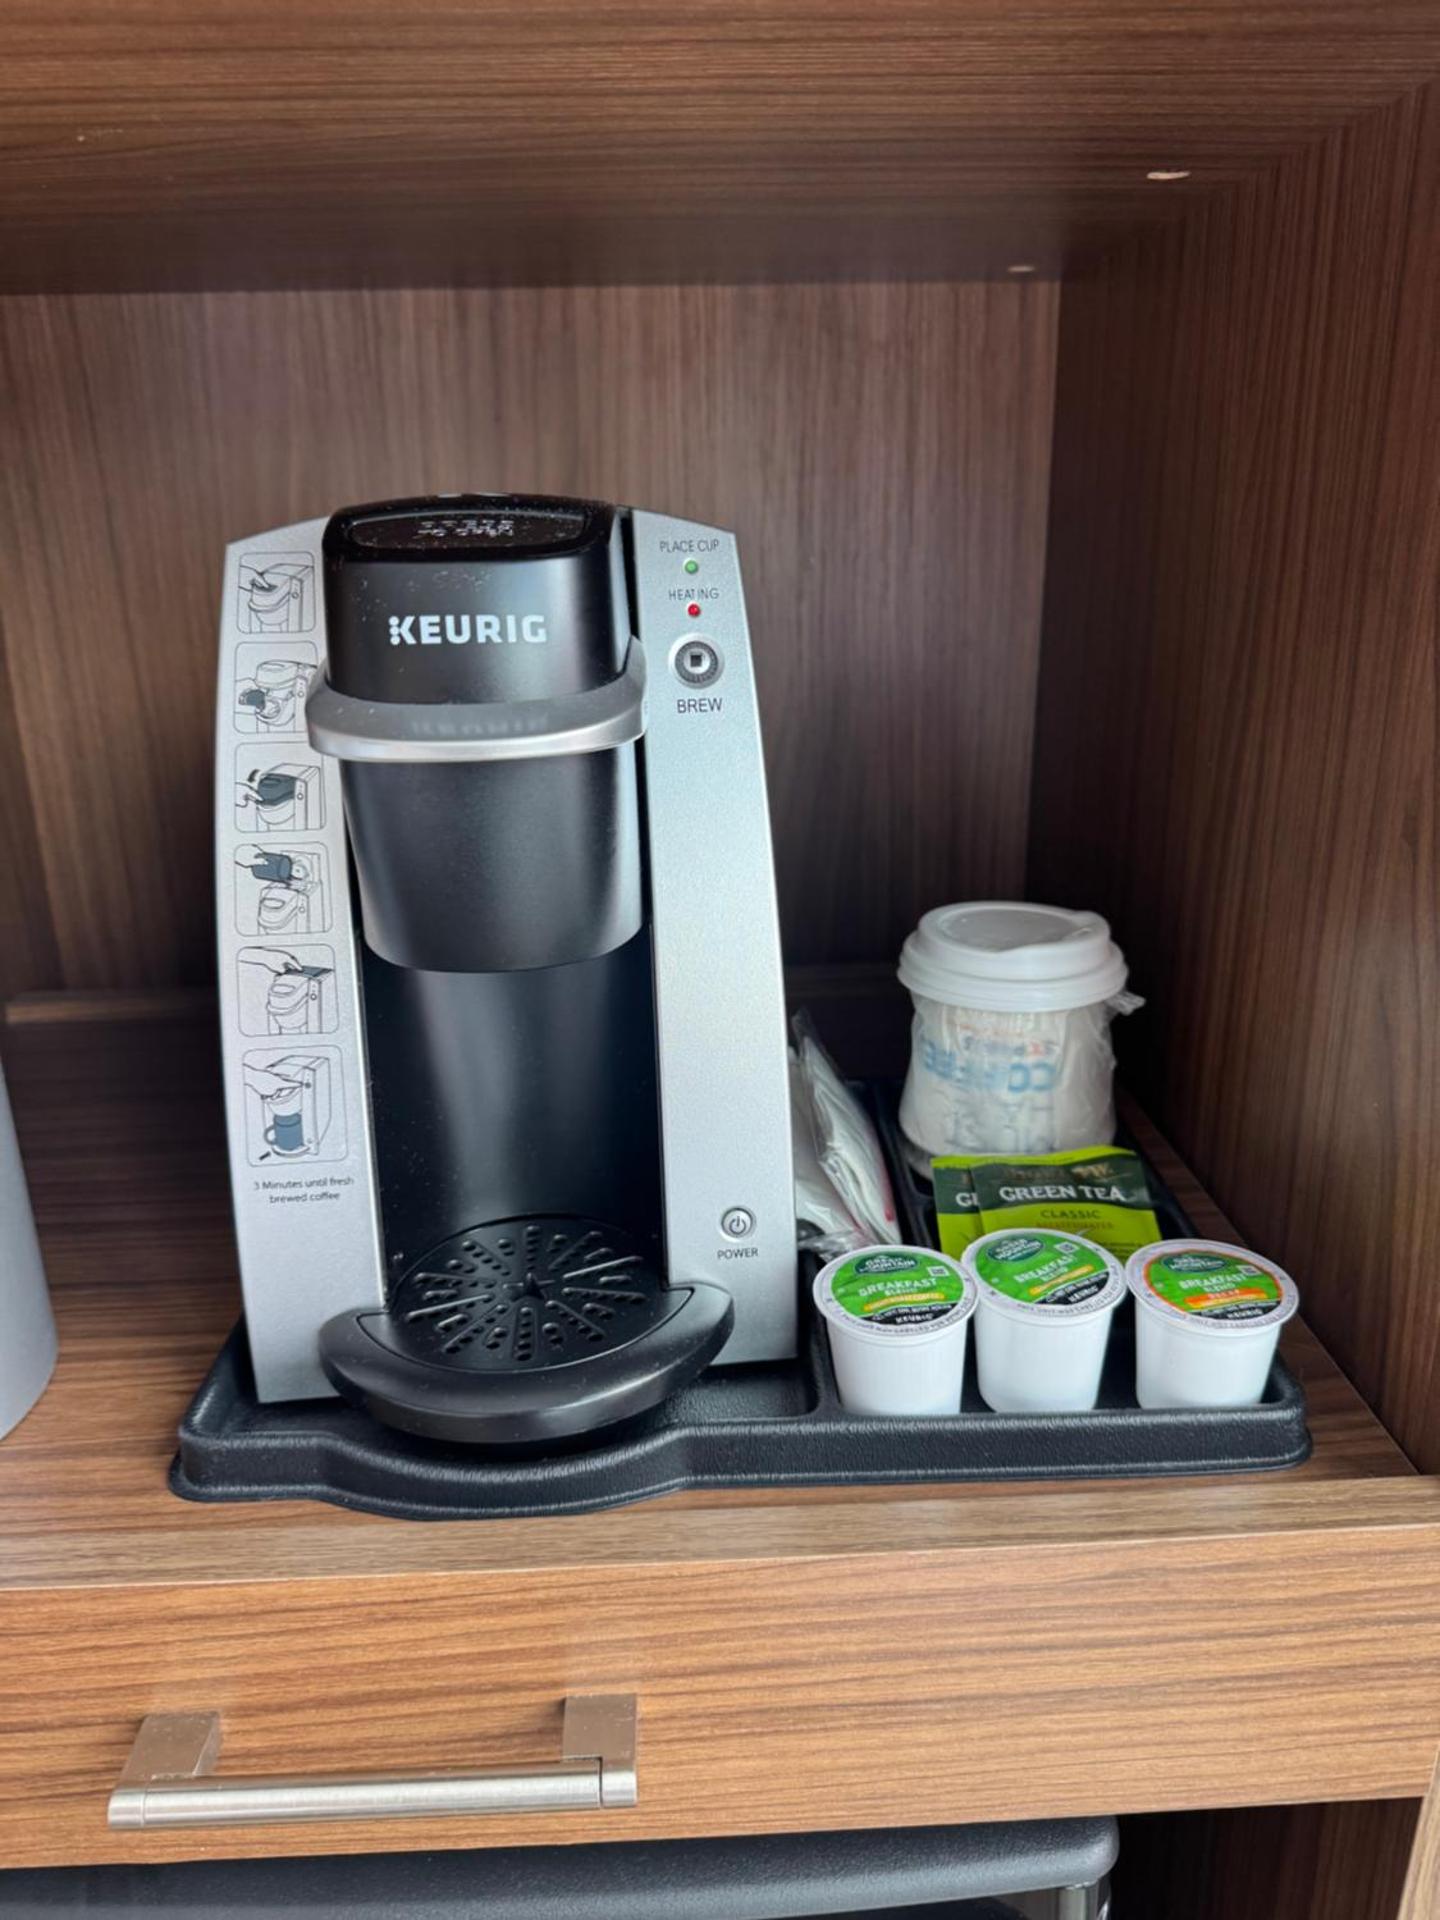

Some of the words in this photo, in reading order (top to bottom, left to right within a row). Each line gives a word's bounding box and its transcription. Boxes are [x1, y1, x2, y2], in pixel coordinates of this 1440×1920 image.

[659, 540, 694, 553] PLACE
[697, 539, 720, 552] CUP
[668, 588, 719, 600] HEATING
[388, 614, 547, 645] KEURIG
[677, 698, 722, 714] BREW
[262, 1180, 303, 1190] Minutes
[305, 1177, 328, 1187] until
[999, 1184, 1077, 1202] GREEN
[1079, 1184, 1128, 1202] TEA
[1040, 1209, 1101, 1221] CLASSIC
[717, 1247, 759, 1260] POWER
